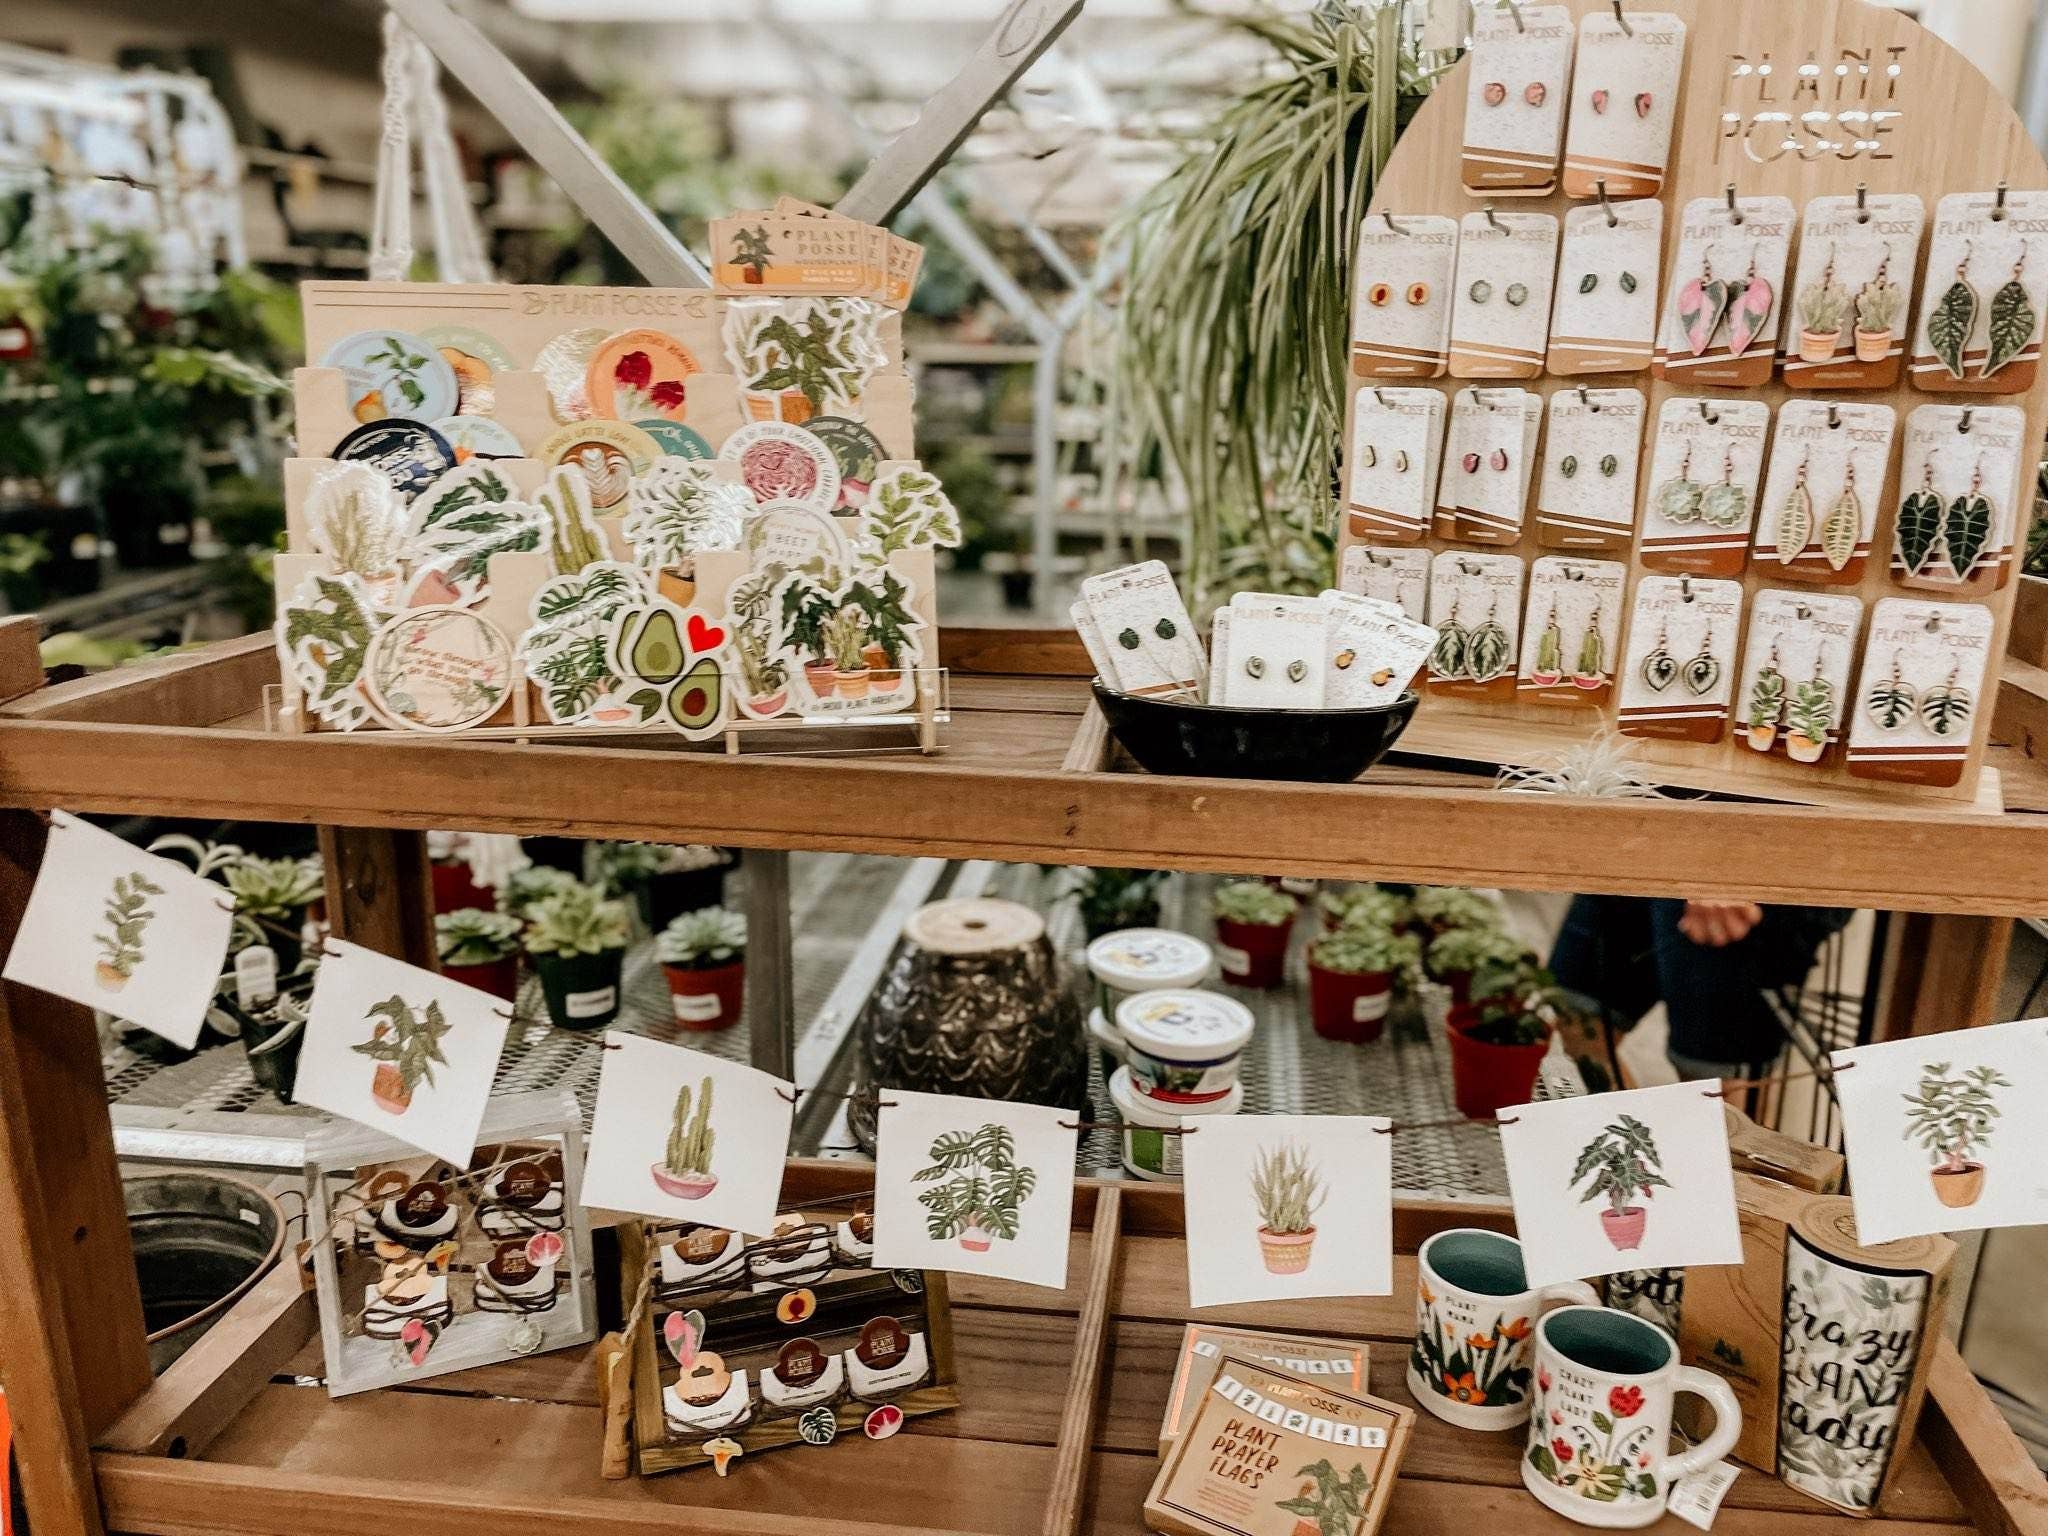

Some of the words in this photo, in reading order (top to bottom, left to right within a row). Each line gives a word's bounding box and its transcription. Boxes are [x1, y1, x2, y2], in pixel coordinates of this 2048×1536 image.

[1527, 26, 1565, 39] POSSE
[1640, 32, 1674, 45] POSSE
[1721, 46, 1907, 106] PLANT
[1713, 110, 1903, 165] POSSE
[1619, 217, 1656, 232] POSSE
[1684, 223, 1723, 240] PLANT
[1744, 222, 1785, 238] POSSE
[1807, 221, 1849, 237] PLANT
[1871, 219, 1914, 236] POSSE
[1939, 219, 1983, 236] PLANT
[797, 230, 857, 241] PLANT
[1364, 232, 1397, 245] PLANT
[1413, 231, 1446, 245] POSSE
[1463, 229, 1498, 241] PLANT
[1512, 229, 1546, 242] POSSE
[798, 243, 858, 255] POSSE
[551, 293, 605, 315] PLANT
[609, 294, 679, 317] POSSE
[1397, 404, 1425, 416] POSSE
[1553, 406, 1585, 417] PLANT
[1602, 404, 1637, 418] POSSE
[1662, 423, 1700, 437] PLANT
[1721, 425, 1762, 439] POSSE
[1781, 425, 1824, 440] PLANT
[1849, 429, 1889, 443] POSSE
[1973, 433, 2013, 447] POSSE
[1135, 573, 1170, 589] POSSE
[1393, 567, 1423, 580] POSSE
[1482, 574, 1515, 587] POSSE
[1585, 576, 1619, 589] POSSE
[1639, 598, 1677, 611] PLANT
[1697, 601, 1733, 616] POSSE
[1758, 611, 1793, 627] PLANT
[1812, 619, 1849, 637] POSSE
[1351, 615, 1384, 633] PLANT
[1395, 632, 1431, 650] POSSE
[1875, 627, 1917, 645] PLANT
[1940, 633, 1984, 649] POSSE
[1446, 1296, 1477, 1311] PLANT
[871, 1337, 895, 1349] PLANT
[1273, 1344, 1308, 1356] POSSE
[789, 1359, 812, 1370] PLANT
[1560, 1368, 1594, 1389] CRAZY
[1266, 1382, 1303, 1398] PLANT
[1303, 1395, 1342, 1415] POSSE
[1559, 1383, 1594, 1404] PLANT
[1560, 1400, 1588, 1418] LADY
[1224, 1418, 1284, 1450] PLANT
[1211, 1435, 1279, 1473] PRAYER
[1209, 1456, 1264, 1489] FLAGS
